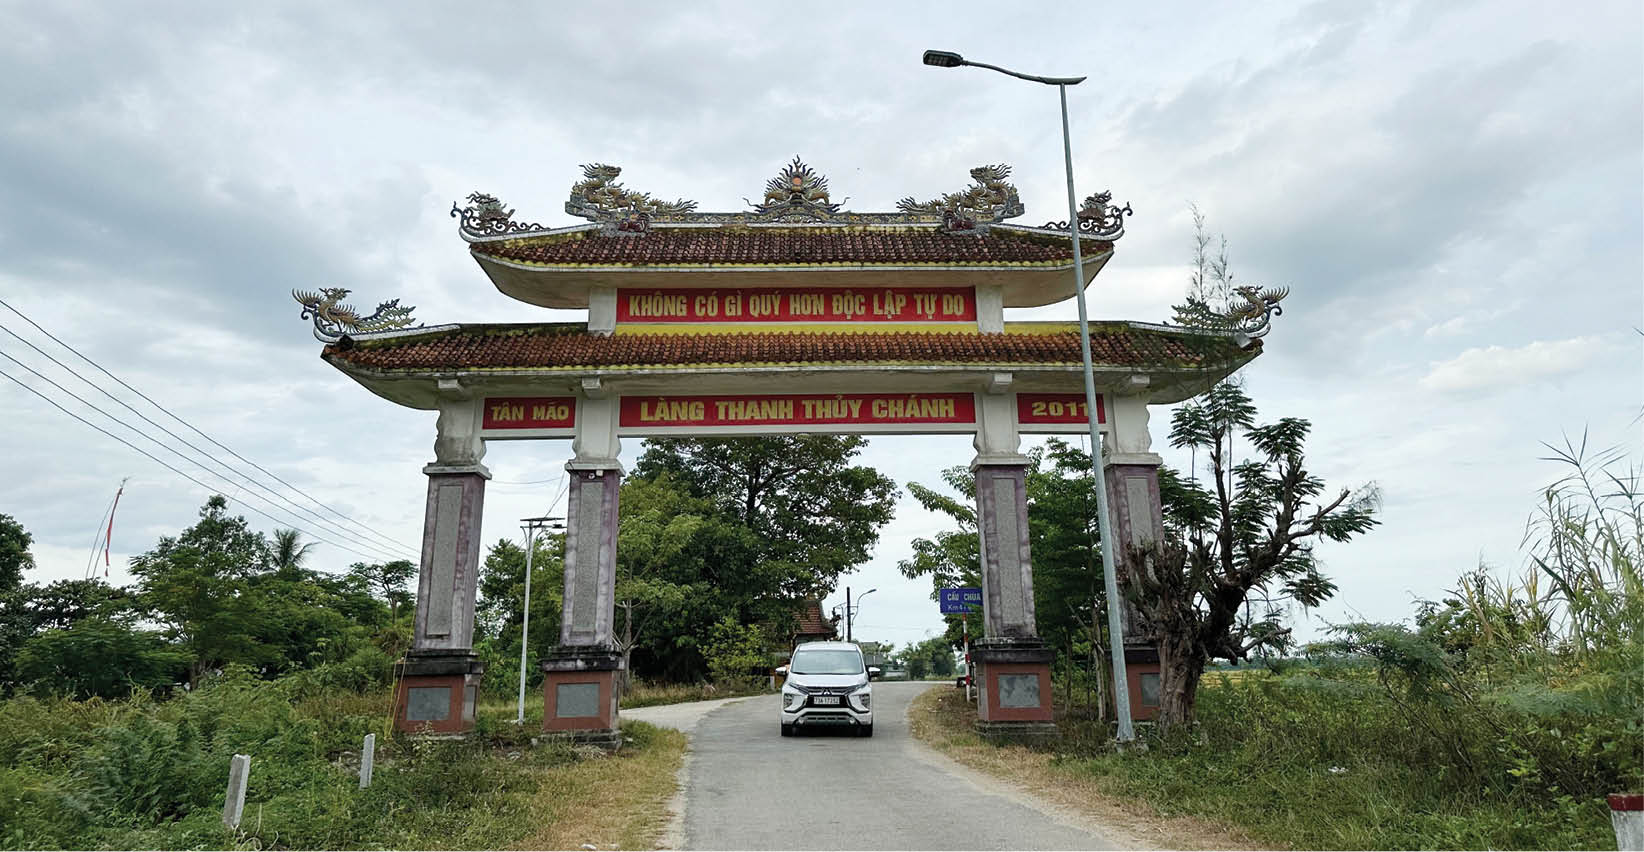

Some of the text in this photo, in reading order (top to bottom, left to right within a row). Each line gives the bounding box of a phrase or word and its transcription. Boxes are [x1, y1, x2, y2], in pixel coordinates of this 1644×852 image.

[628, 290, 688, 317] KHÔNG
[694, 290, 719, 317] CÓ
[724, 289, 743, 317] GÌ
[749, 290, 782, 318] QUÝ
[831, 289, 866, 320] ĐỘC
[872, 289, 907, 320] LẬP
[913, 293, 938, 320] TỰ
[942, 294, 965, 316] DO
[490, 401, 525, 421] TÂN
[640, 393, 956, 421] LÀNG THANH THỦY CHÁNH
[1031, 401, 1089, 417] 2011
